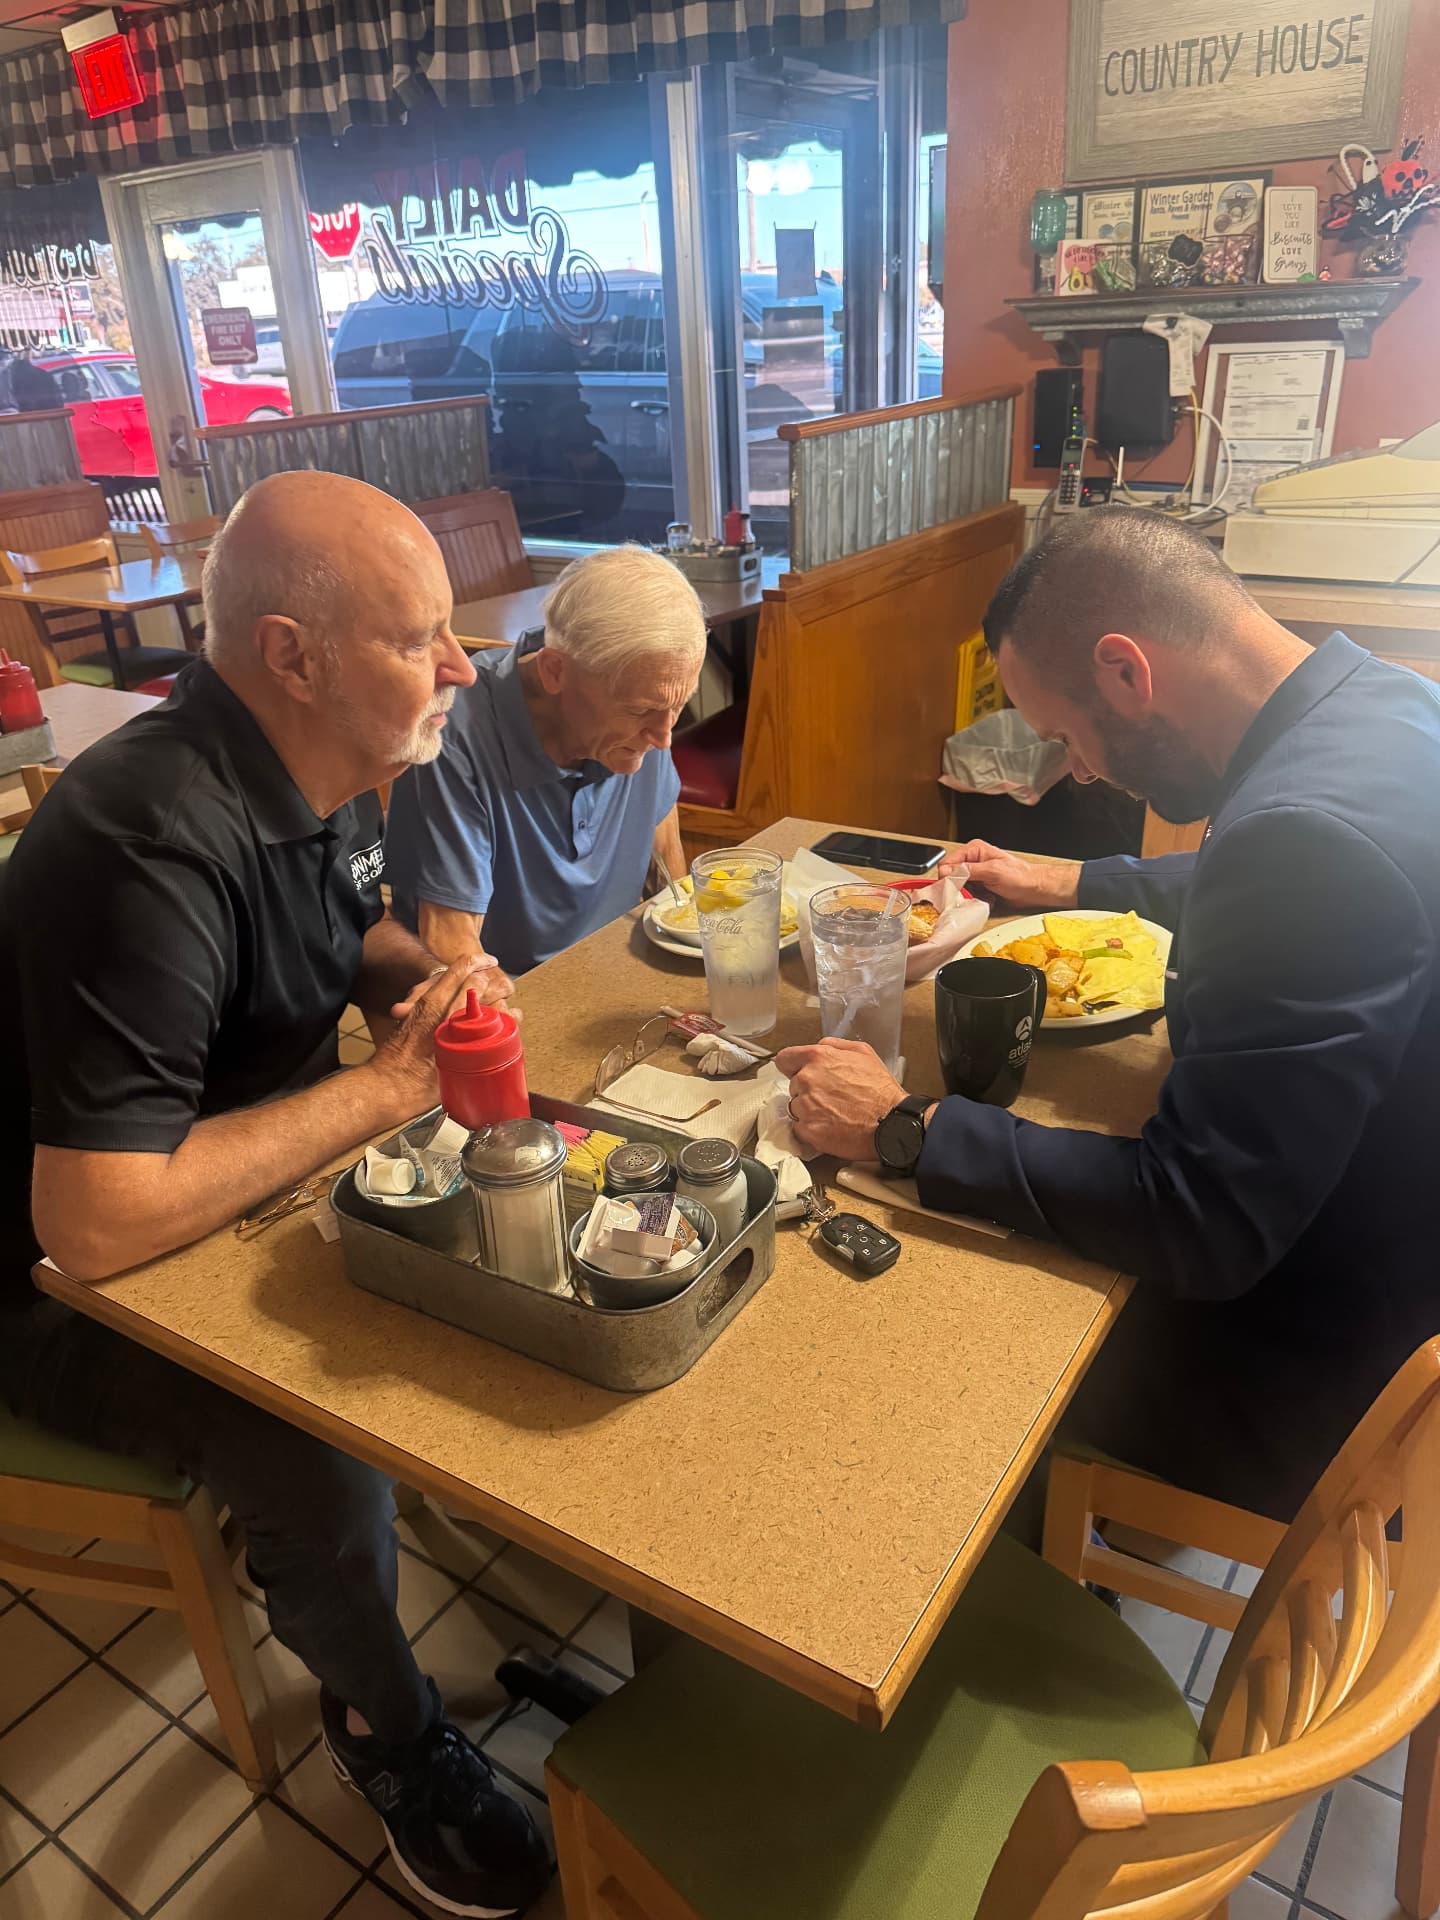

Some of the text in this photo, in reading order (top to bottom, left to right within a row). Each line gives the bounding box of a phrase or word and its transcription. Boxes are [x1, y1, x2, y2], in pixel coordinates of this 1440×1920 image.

[1104, 14, 1364, 96] COUNTRY HOUSE
[84, 43, 132, 109] EXIT
[1150, 190, 1214, 207] Winter Garden
[1282, 203, 1302, 211] LOVE
[310, 202, 357, 233] STOP
[1271, 231, 1312, 245] Biscuits
[1281, 247, 1302, 255] LOVE
[1273, 256, 1307, 273] Gravy
[211, 323, 246, 336] FIRE EXIT
[218, 334, 242, 347] ONLY
